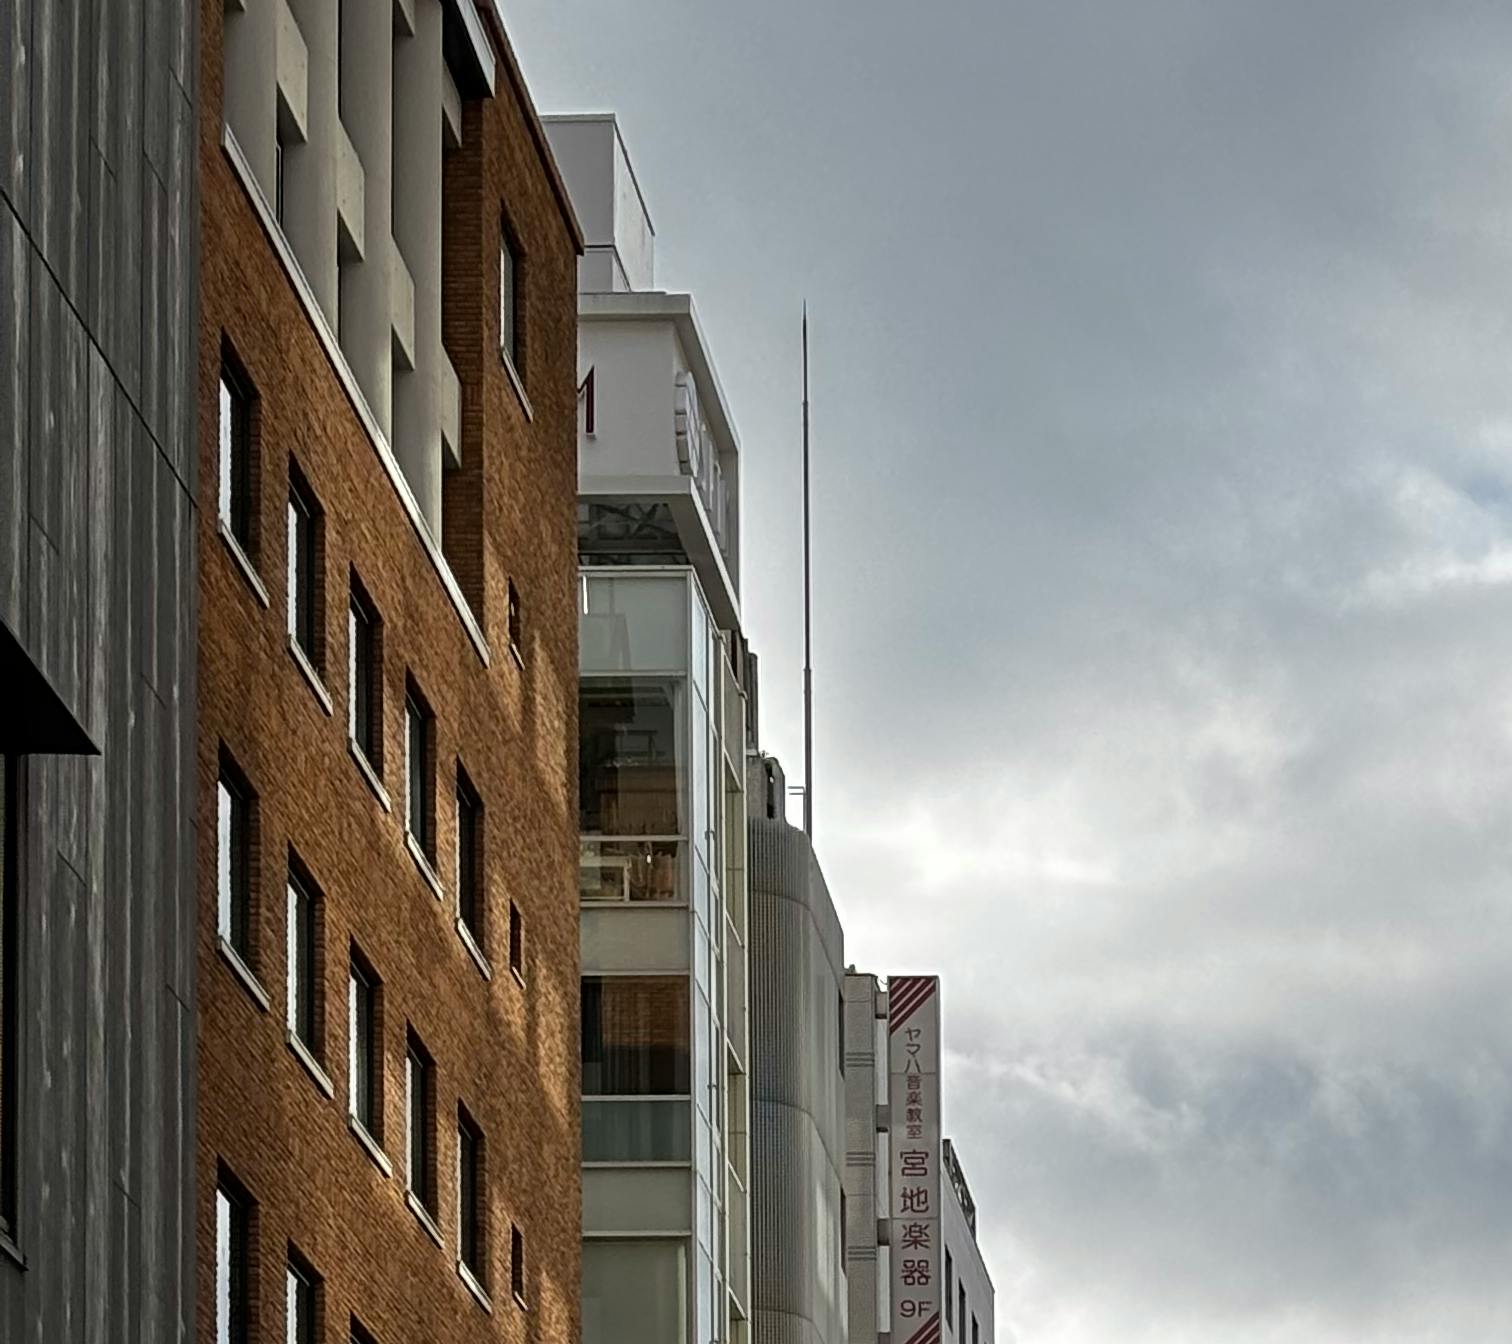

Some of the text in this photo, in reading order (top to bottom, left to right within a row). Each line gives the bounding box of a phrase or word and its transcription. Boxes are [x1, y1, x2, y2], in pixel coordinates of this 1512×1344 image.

[904, 1027, 923, 1139] ヤマハ音楽教室
[899, 1149, 932, 1286] 宮地楽器
[899, 1299, 933, 1317] 9F
